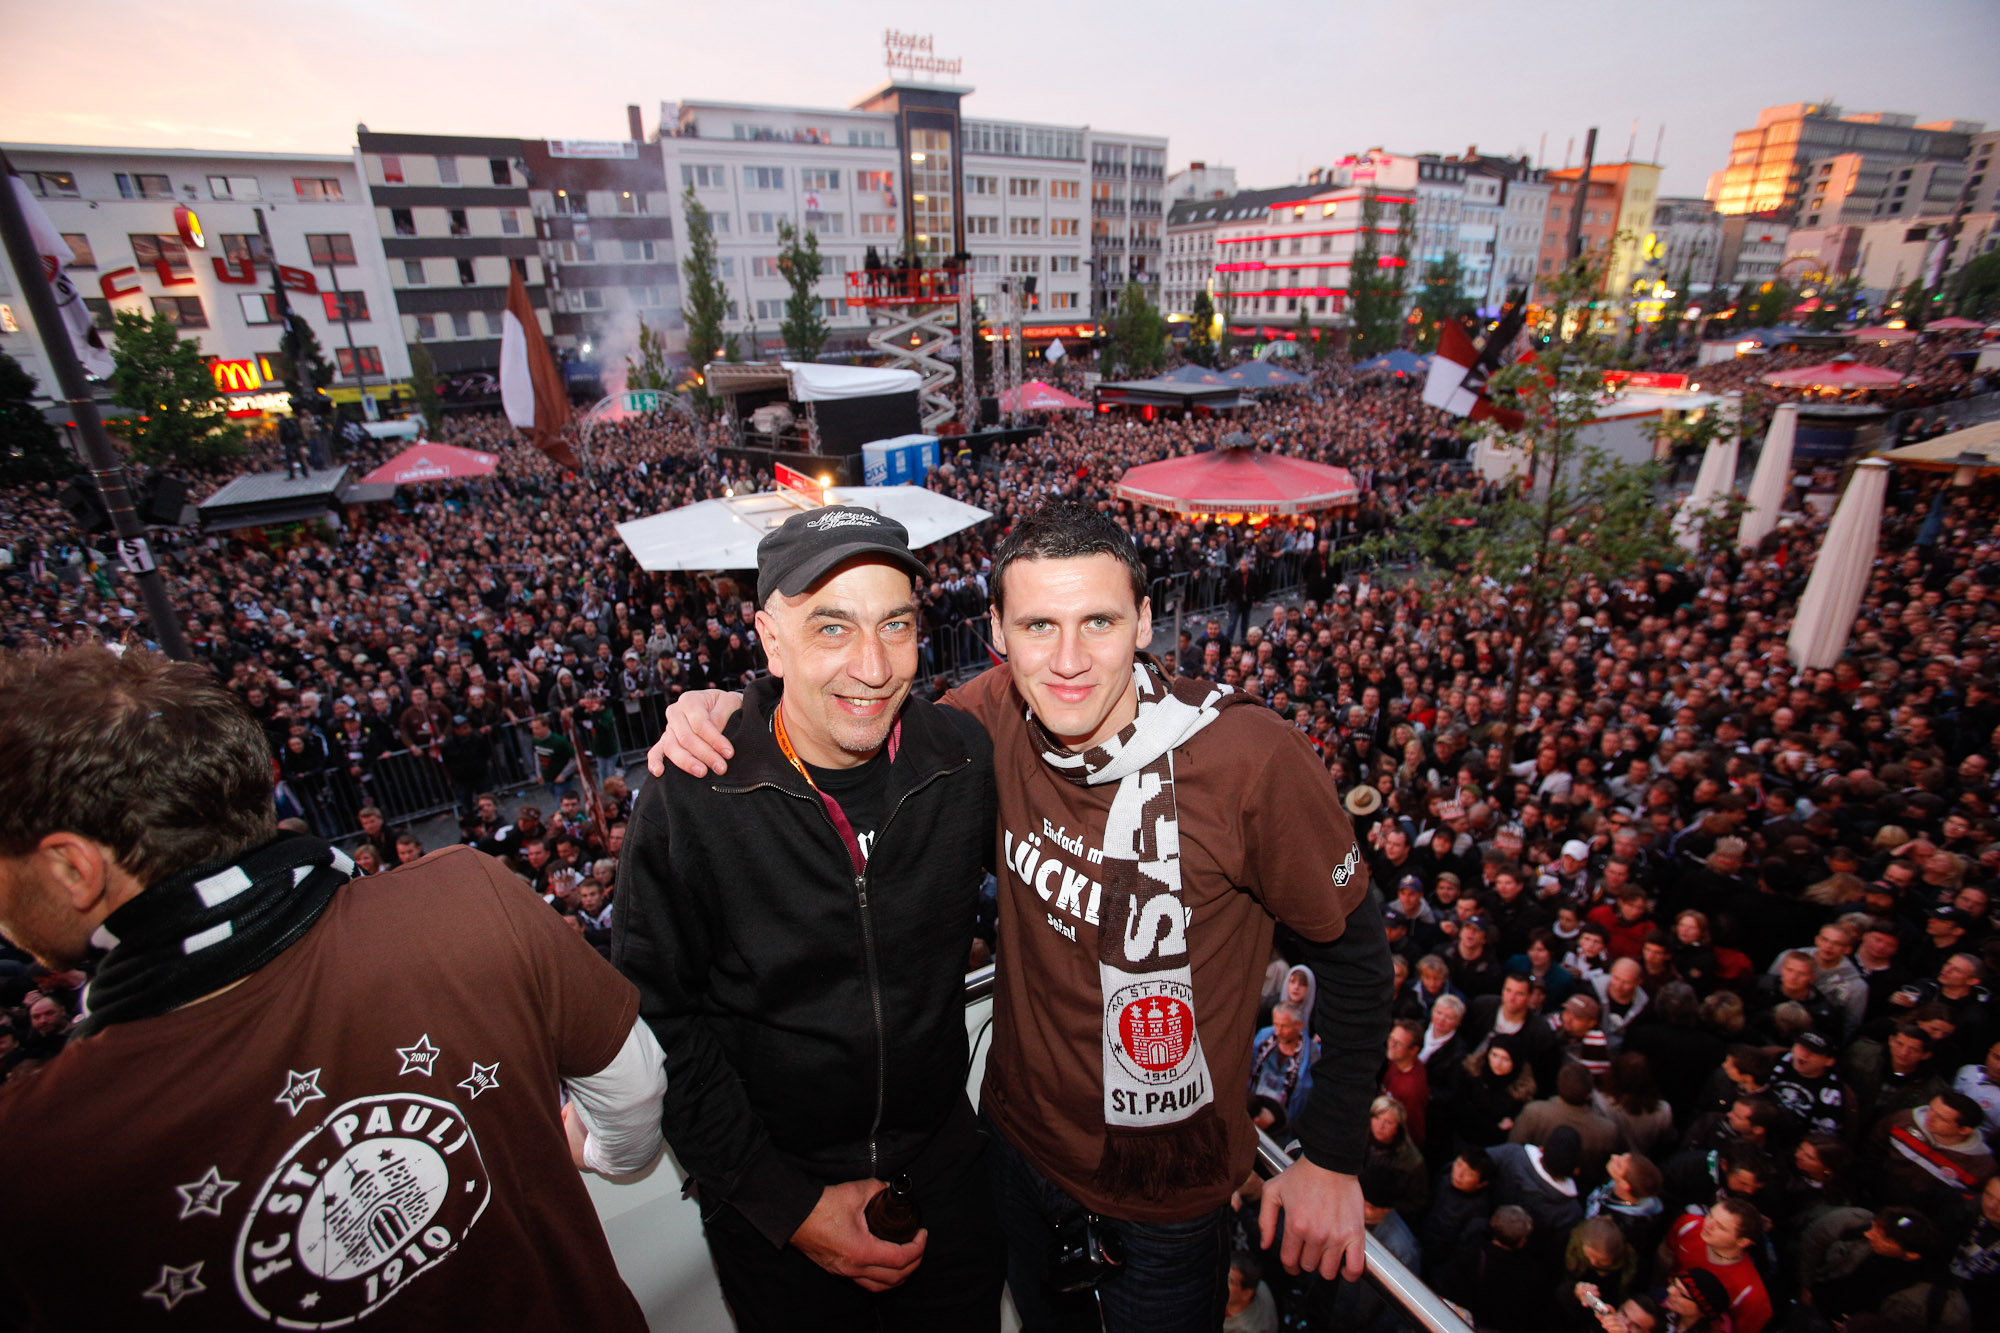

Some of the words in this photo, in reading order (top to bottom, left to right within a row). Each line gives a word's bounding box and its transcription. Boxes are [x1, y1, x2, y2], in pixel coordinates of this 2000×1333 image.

[884, 27, 933, 51] Hotel
[99, 255, 320, 302] CLUB
[1043, 817, 1084, 857] Einfach
[1047, 912, 1077, 942] sein!
[1160, 984, 1192, 1002] PAUL
[410, 1052, 432, 1063] 2001
[290, 1079, 312, 1099] 1995
[473, 1072, 490, 1087] 2010
[1143, 1068, 1178, 1081] 1910
[332, 1104, 469, 1156] PAULI
[266, 1157, 329, 1215] ST.
[251, 1231, 293, 1284] FC
[365, 1225, 451, 1304] 1910
